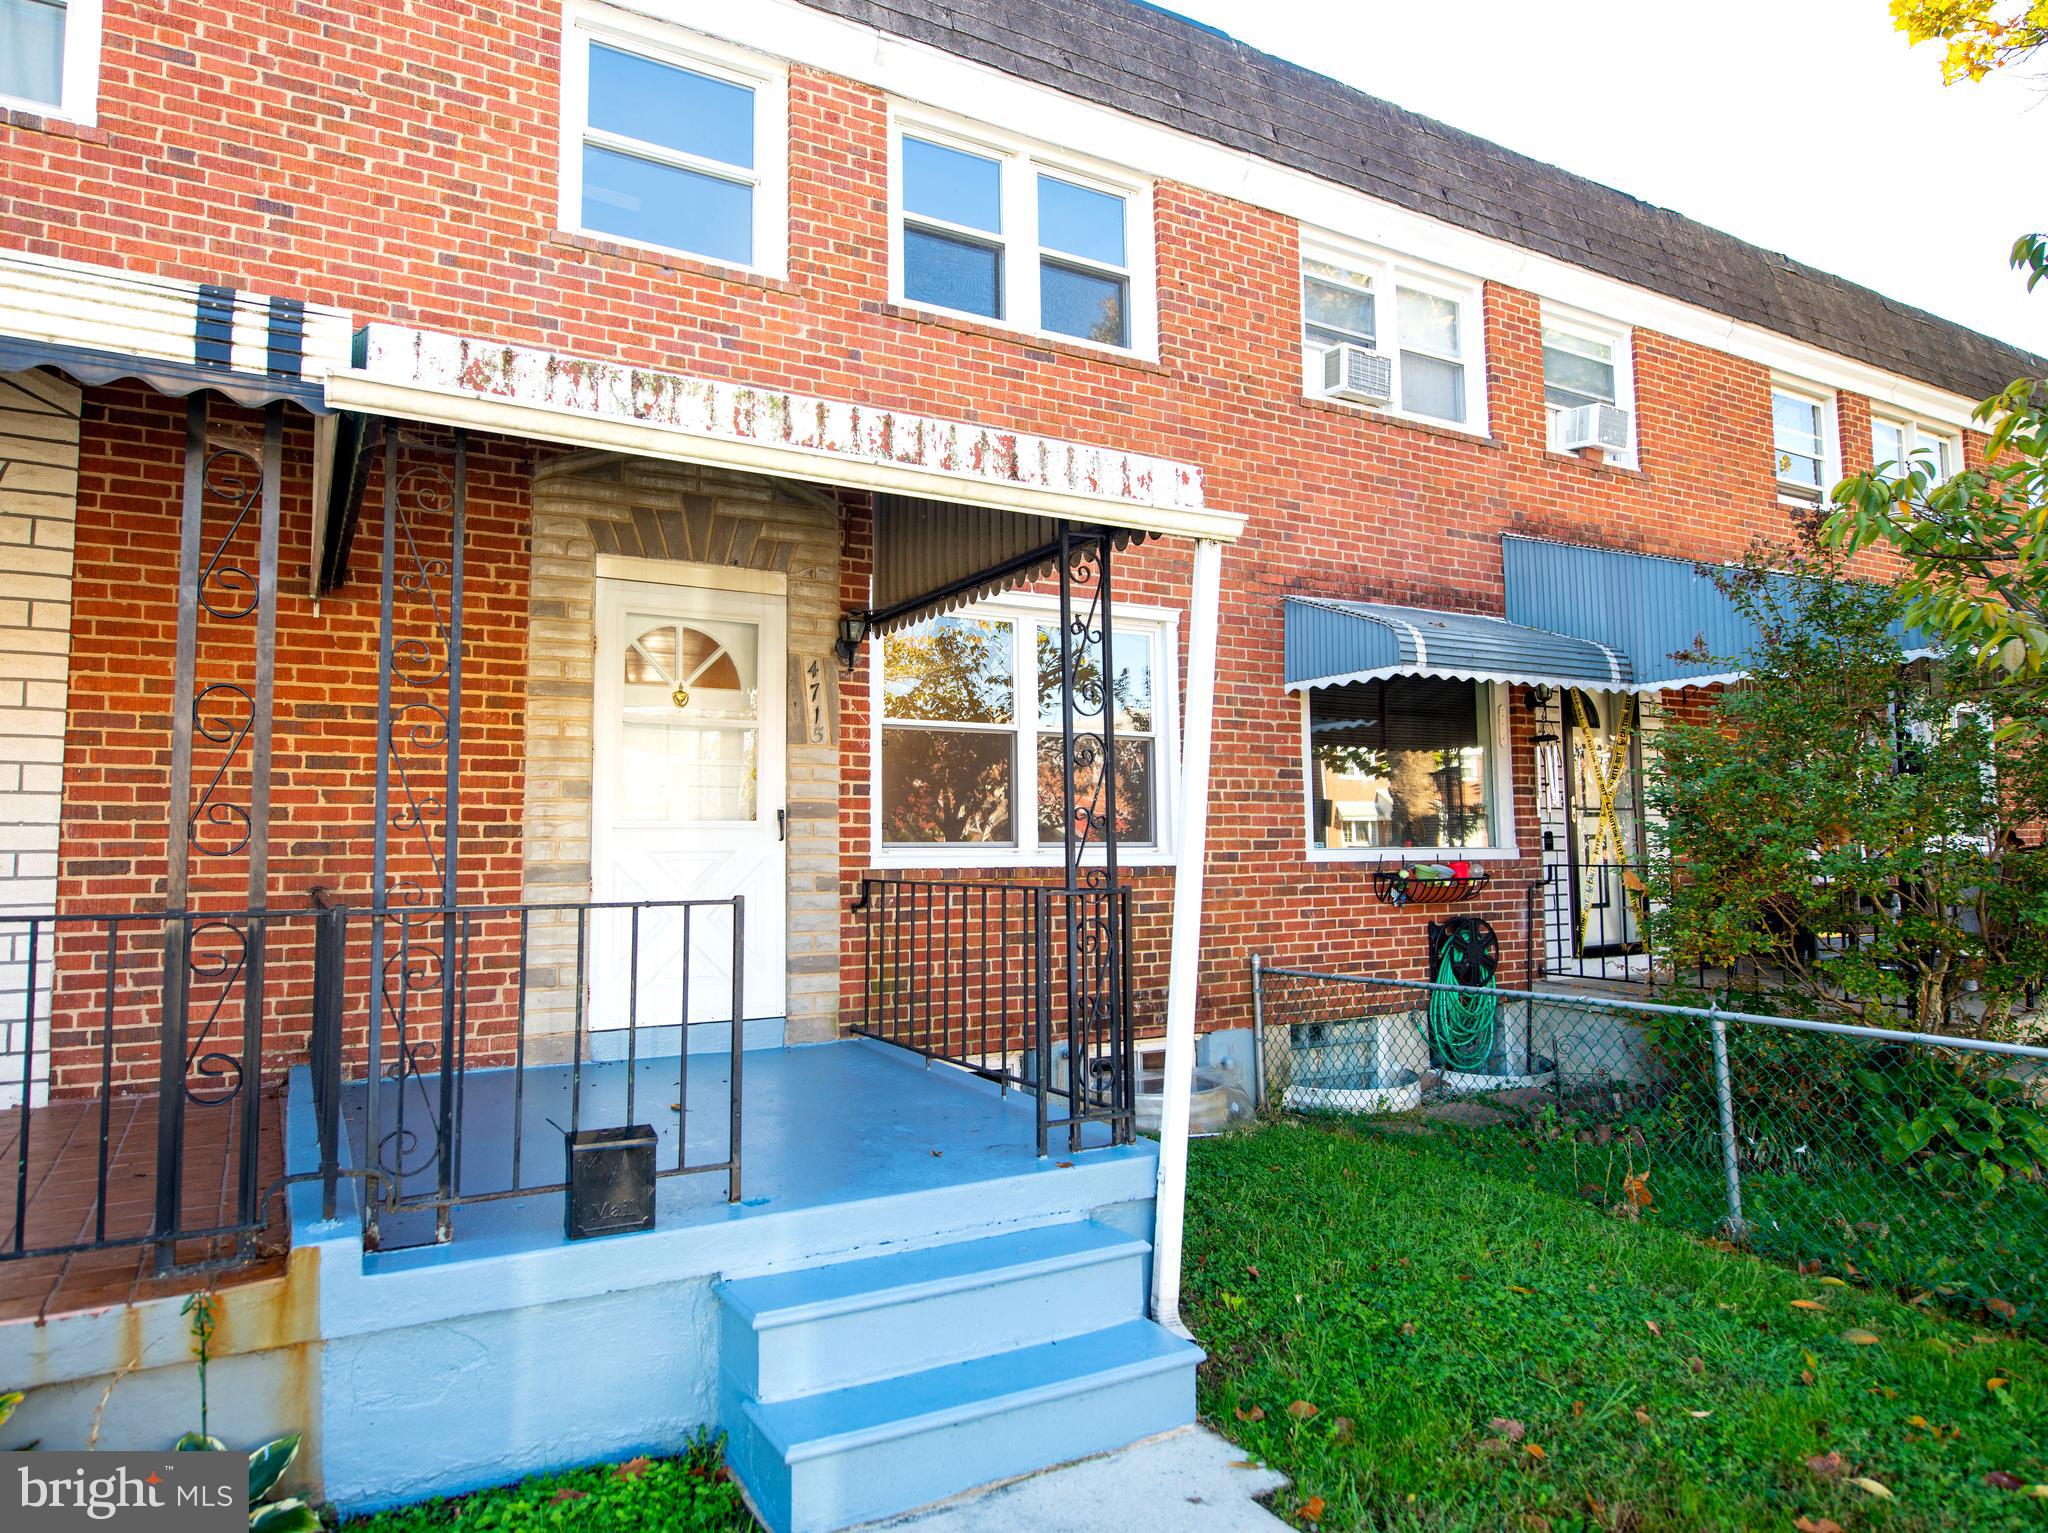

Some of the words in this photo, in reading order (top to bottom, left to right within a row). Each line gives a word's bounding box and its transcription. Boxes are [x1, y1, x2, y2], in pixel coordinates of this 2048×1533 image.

[807, 660, 824, 744] 4715
[1619, 712, 1630, 738] CAUTION
[1614, 751, 1623, 764] OUT
[1611, 765, 1620, 781] KEEP
[1594, 765, 1603, 781] KEEP
[1599, 783, 1607, 796] OUT
[1607, 810, 1619, 837] CAUTION
[1615, 839, 1624, 856] KEEP
[1593, 838, 1601, 855] KEEP
[591, 1198, 640, 1221] Mail
